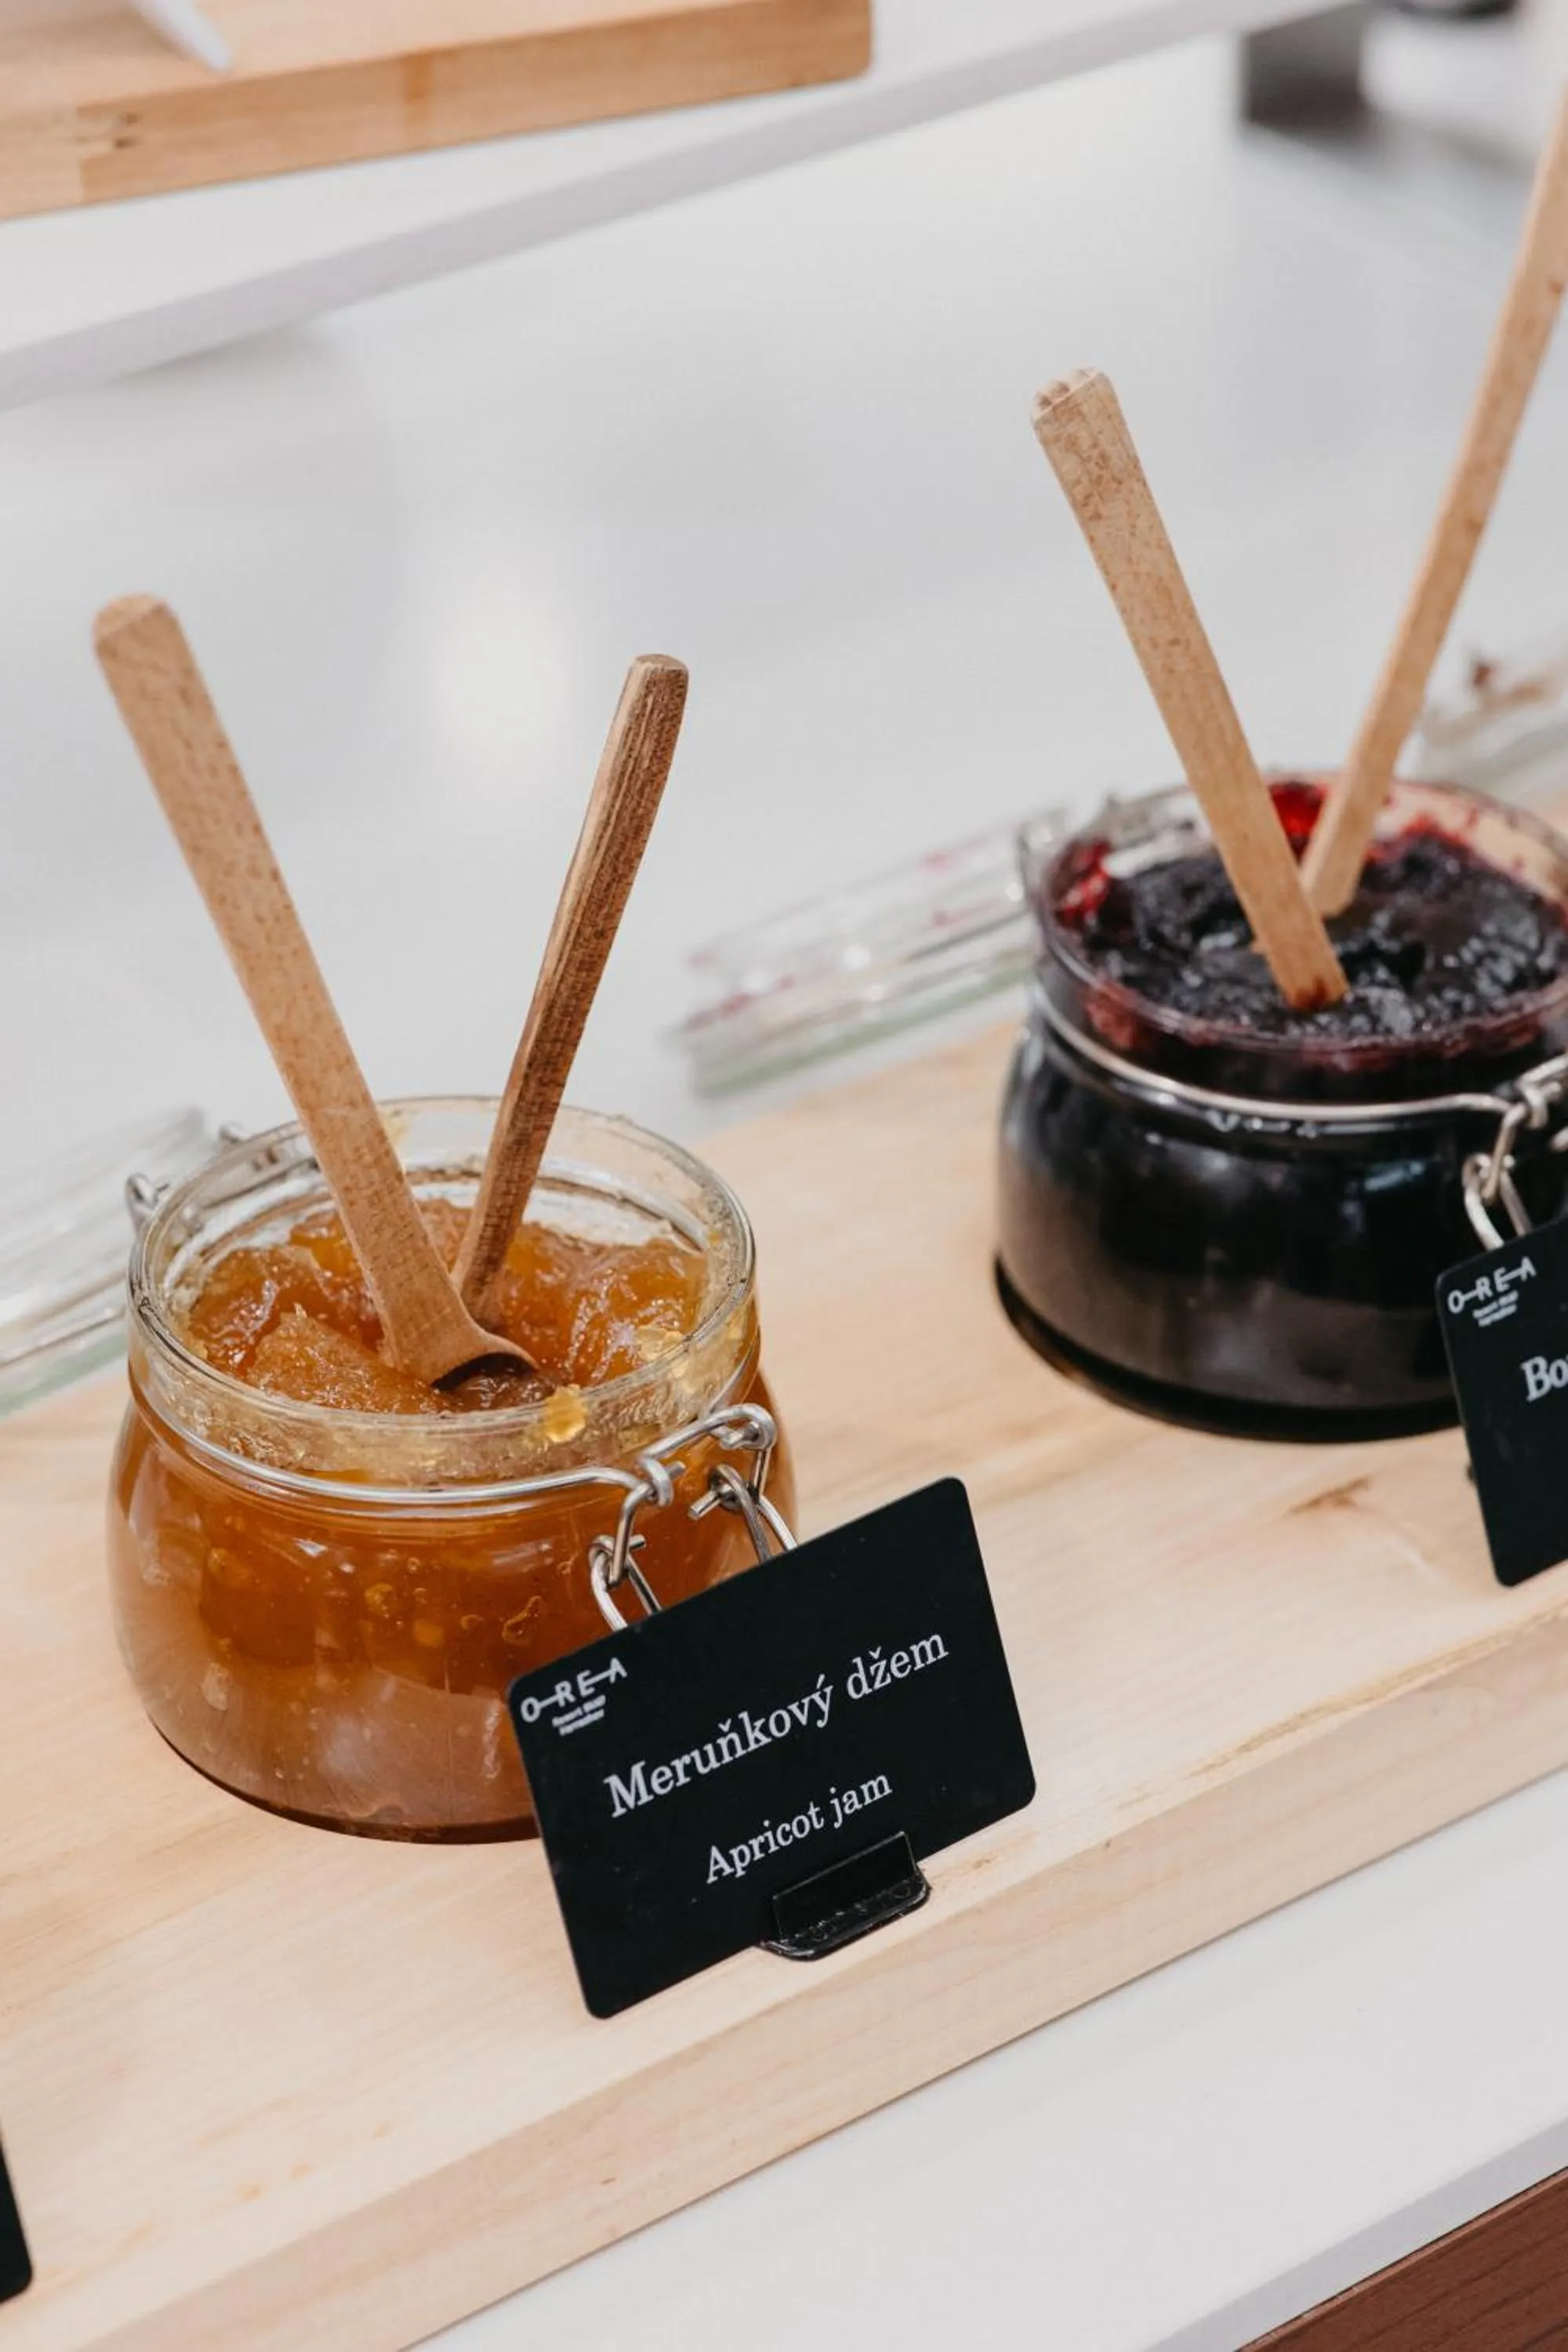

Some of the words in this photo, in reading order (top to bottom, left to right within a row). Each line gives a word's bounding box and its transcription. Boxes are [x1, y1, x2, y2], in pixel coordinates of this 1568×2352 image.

[1520, 1355, 1568, 1402] Bo
[602, 1674, 833, 1819] Meruňkový
[846, 1633, 950, 1700] džem
[706, 1801, 825, 1884] Apricot
[829, 1775, 893, 1829] jam
